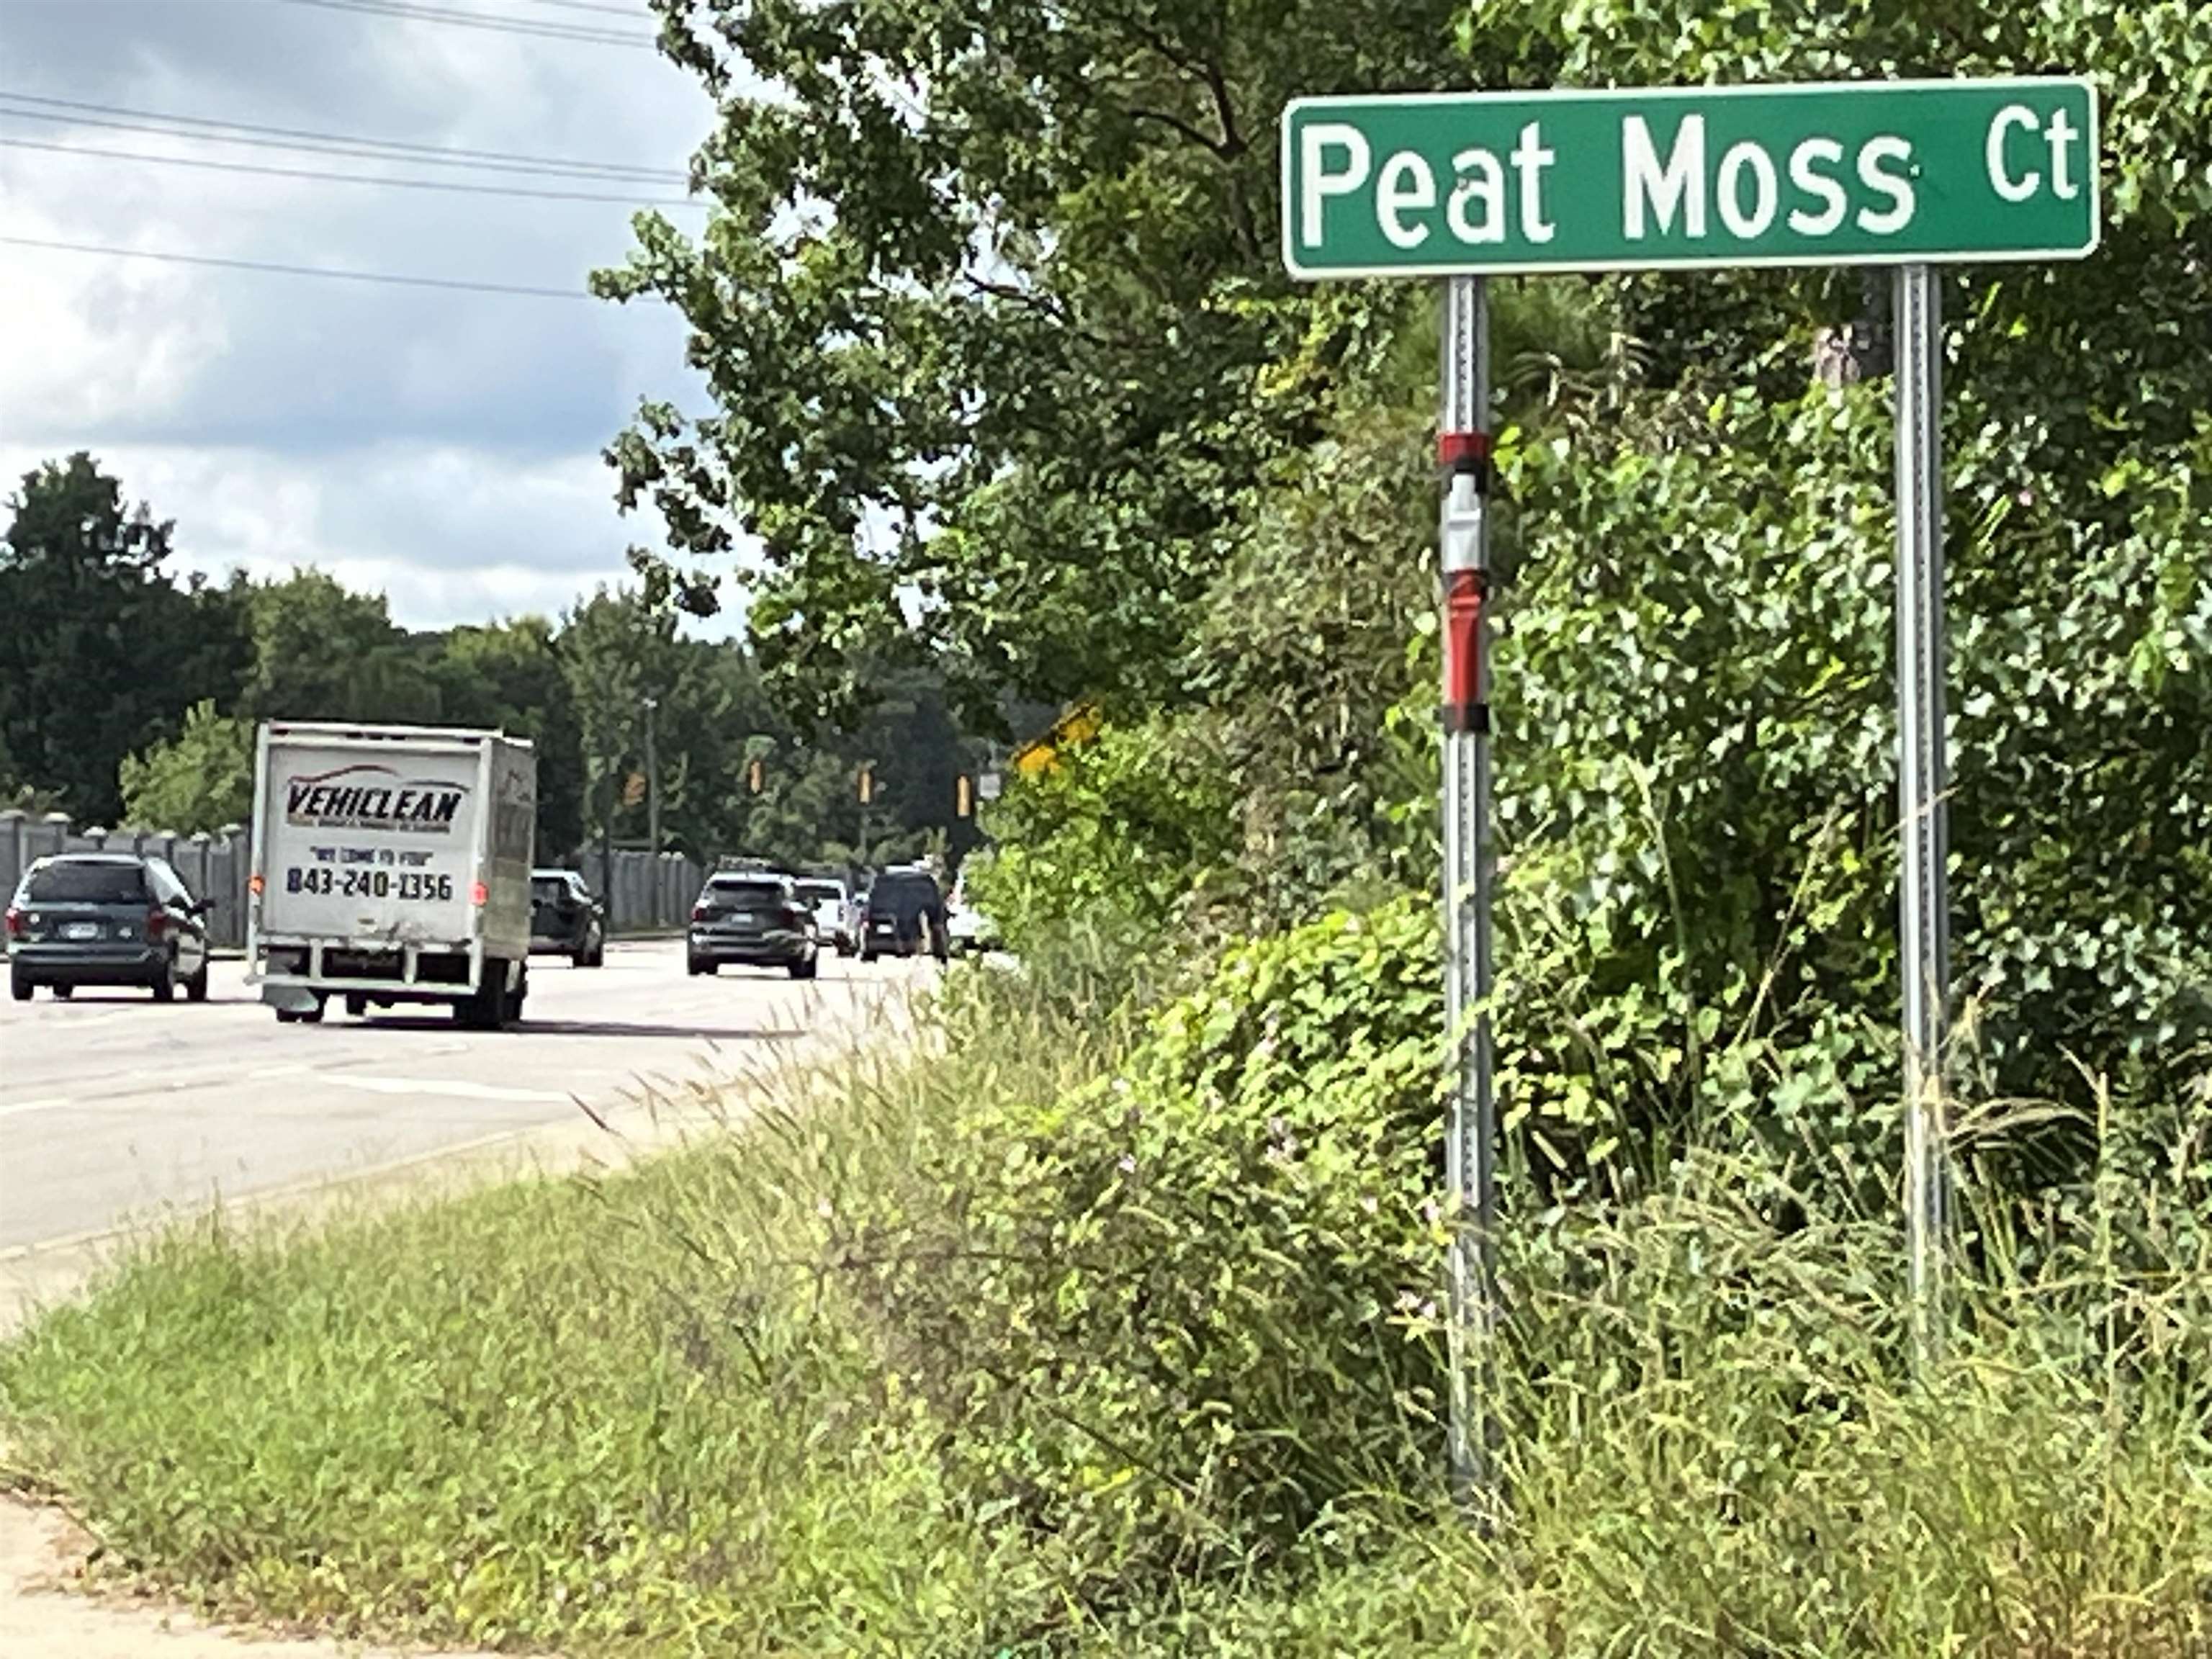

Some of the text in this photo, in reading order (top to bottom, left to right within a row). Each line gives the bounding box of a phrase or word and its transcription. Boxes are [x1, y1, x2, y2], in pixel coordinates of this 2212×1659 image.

[1301, 104, 2080, 248] Peat Moss Ct
[288, 783, 462, 822] VEHICLEAN
[287, 867, 452, 900] 843-240-1356
